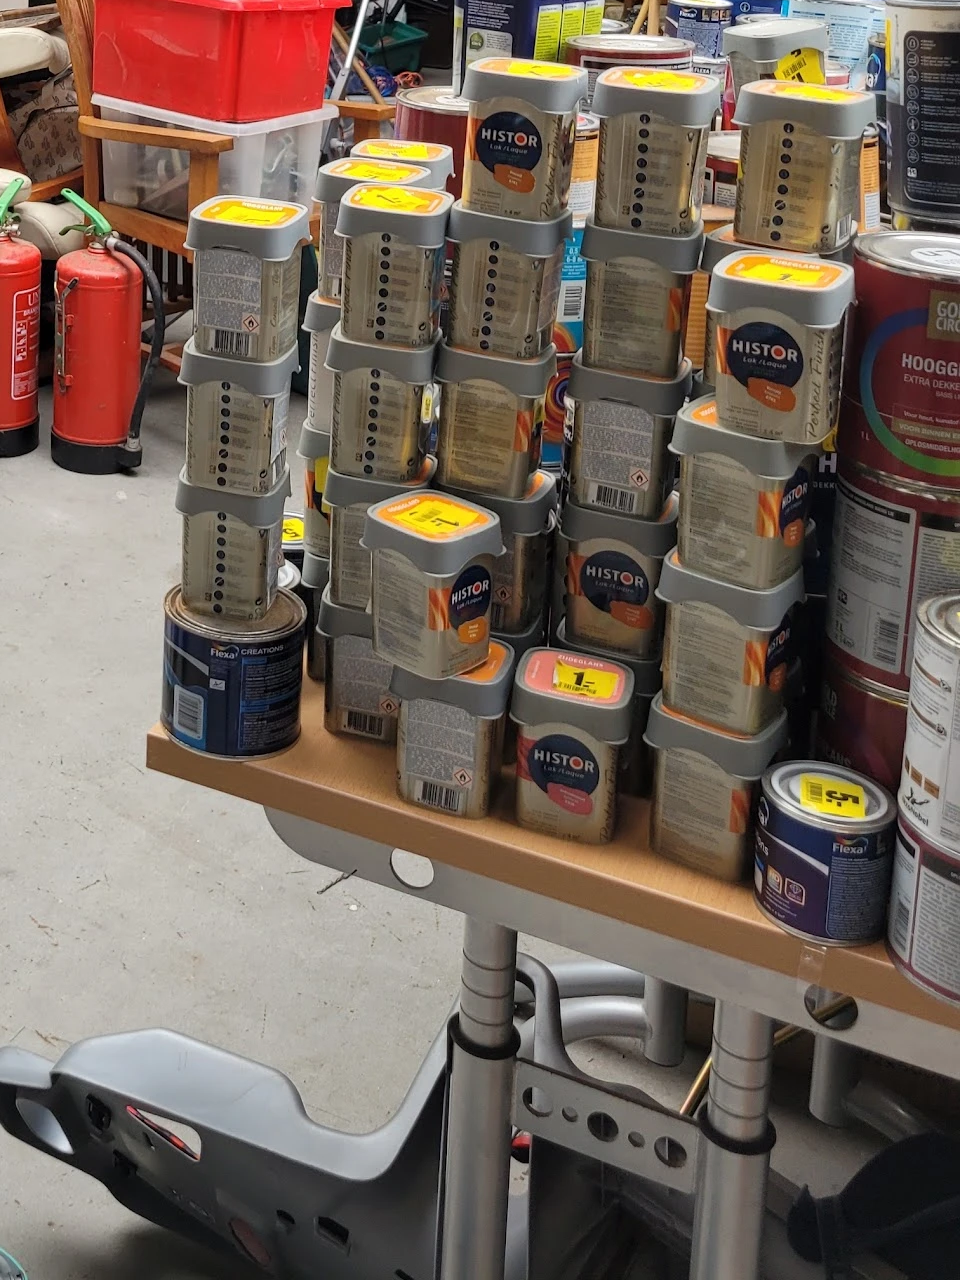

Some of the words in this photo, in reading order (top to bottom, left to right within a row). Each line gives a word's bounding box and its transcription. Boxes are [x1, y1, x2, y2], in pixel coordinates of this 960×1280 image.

[481, 127, 538, 148] HISTOR
[937, 301, 960, 319] GO
[732, 338, 798, 363] HISTOR
[809, 329, 826, 376] Finish
[901, 352, 960, 377] HOOGG
[903, 373, 930, 388] EXTRA
[805, 381, 822, 440] Perfect
[899, 423, 920, 433] VOOR
[921, 428, 951, 439] BINNEN
[586, 564, 644, 589] HISTOR
[451, 579, 489, 606] HISTOR
[210, 647, 235, 660] Flexa
[241, 644, 284, 656] CREATIONS
[533, 747, 595, 773] HISTOR
[832, 842, 864, 855] Flexa
